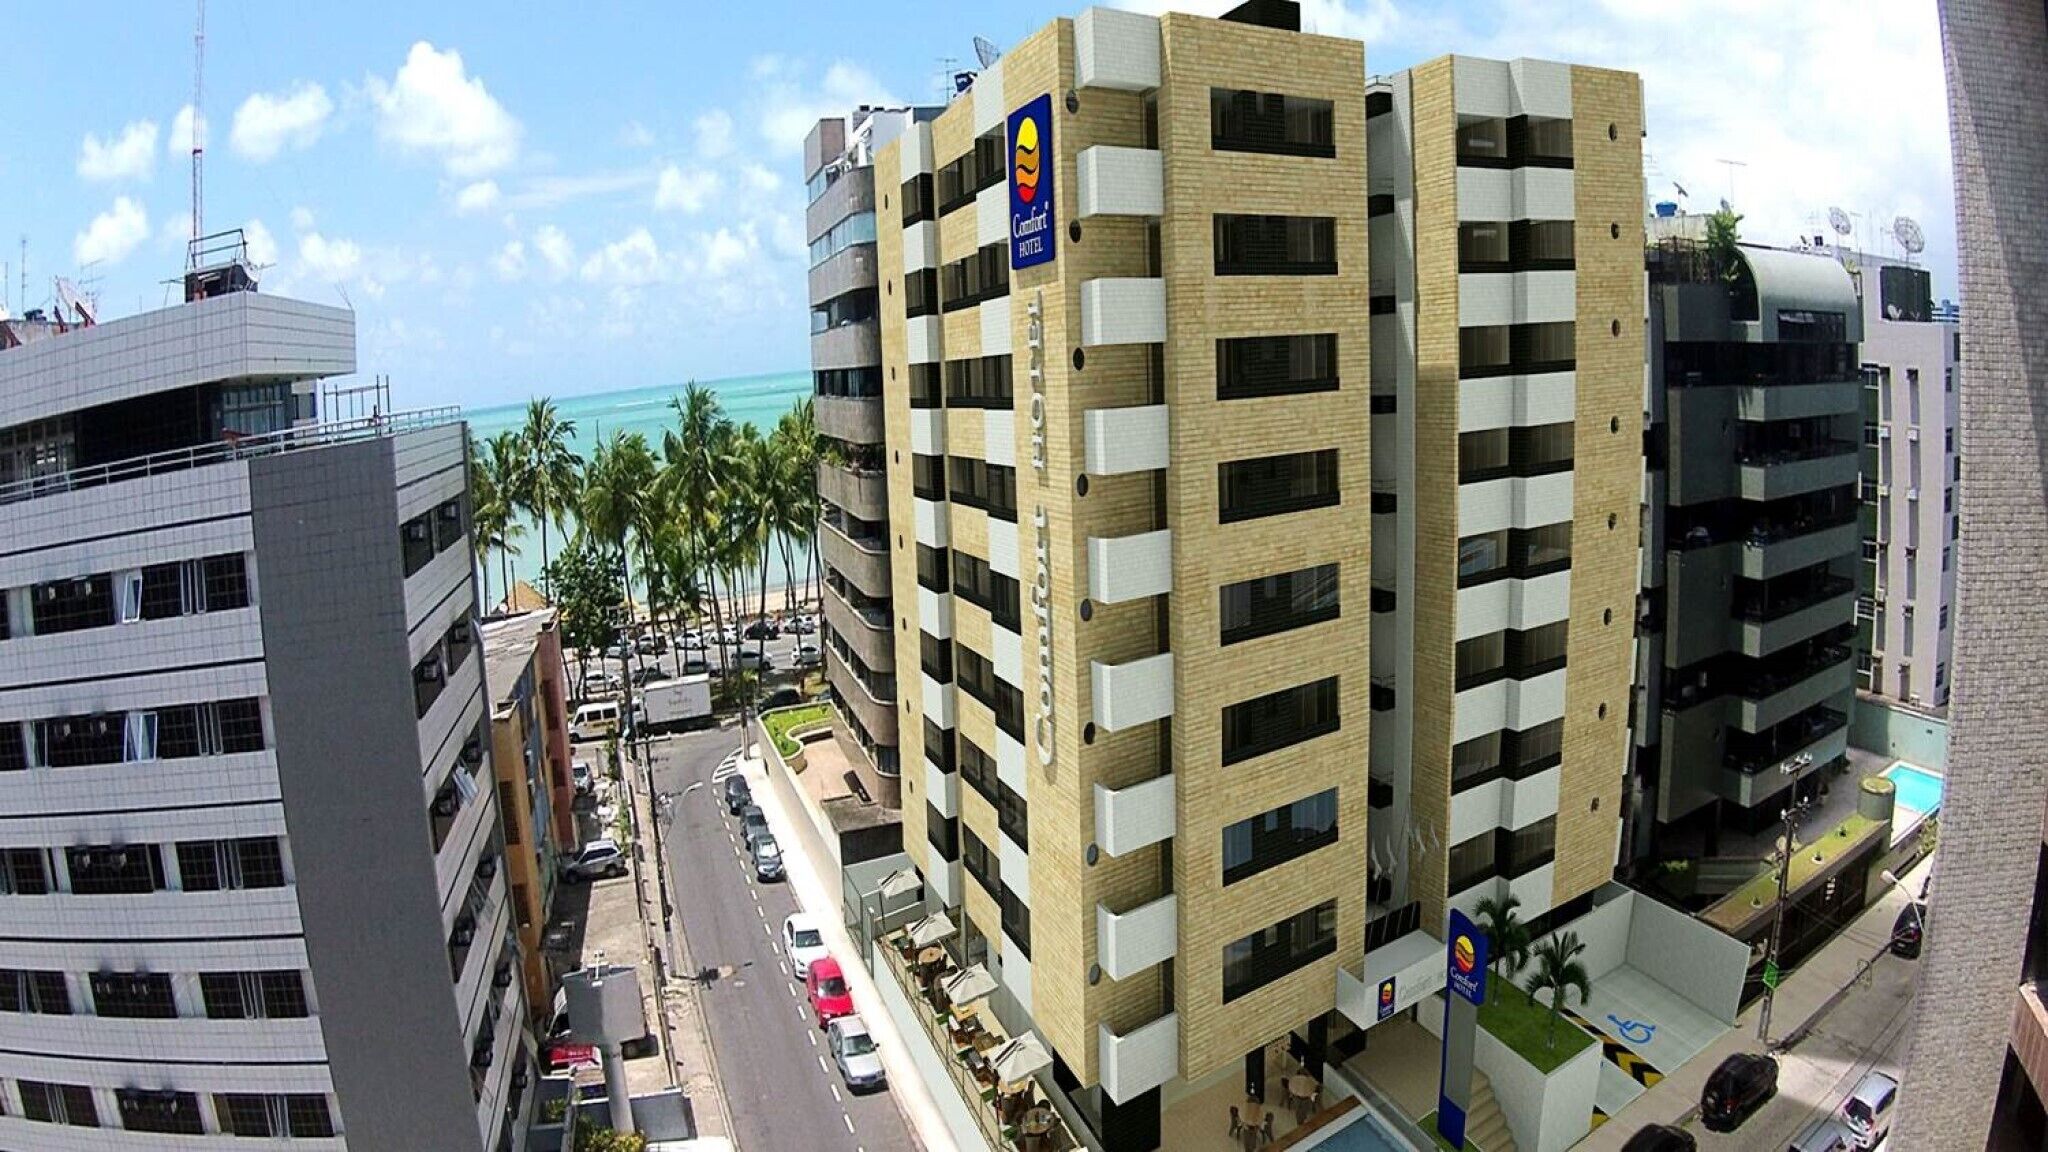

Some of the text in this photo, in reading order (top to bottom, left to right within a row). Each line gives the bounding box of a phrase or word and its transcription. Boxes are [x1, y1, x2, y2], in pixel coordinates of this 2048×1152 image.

[1012, 204, 1048, 238] Comfort
[1018, 236, 1043, 259] HOTEL
[1031, 504, 1055, 765] Comfort
